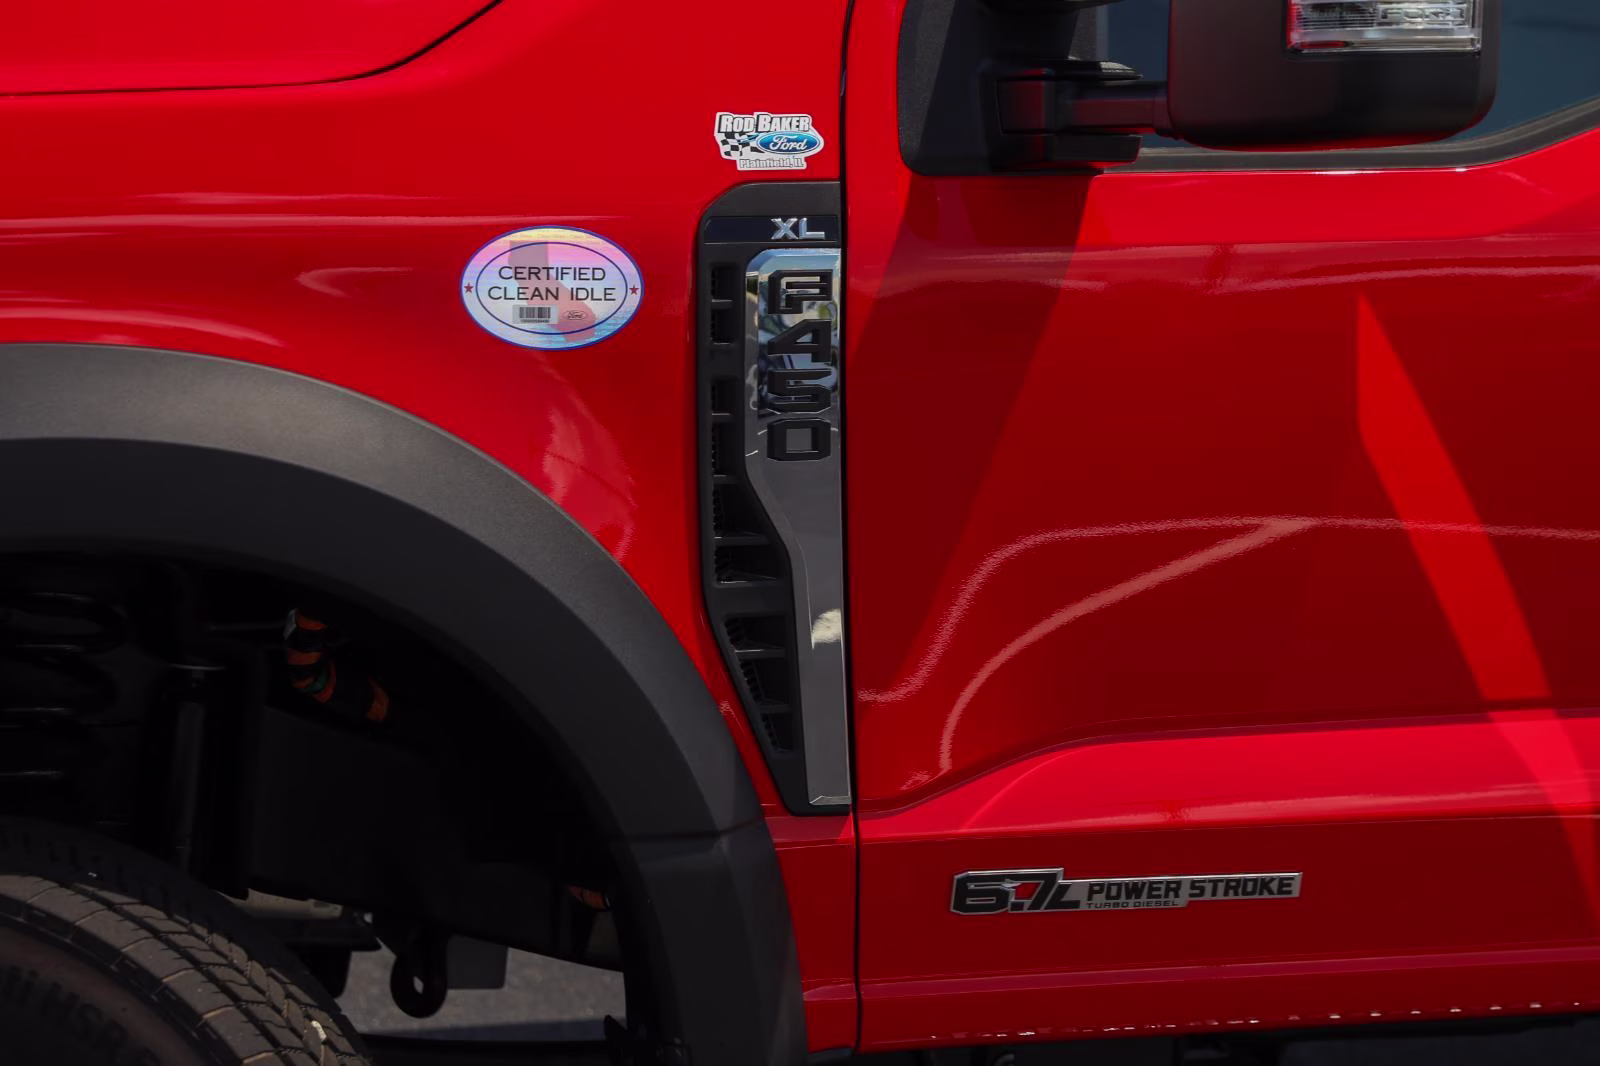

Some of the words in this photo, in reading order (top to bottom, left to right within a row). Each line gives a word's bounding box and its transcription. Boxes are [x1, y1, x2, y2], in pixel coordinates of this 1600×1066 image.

[756, 114, 810, 133] BAKER
[769, 135, 808, 150] Ford
[771, 217, 825, 240] XL
[498, 266, 606, 281] CERTIFIED
[487, 286, 559, 301] CLEAN
[570, 287, 616, 301] IDLE
[951, 868, 1081, 915] 6.7L
[1087, 880, 1182, 901] POWER
[1188, 876, 1295, 898] STROKE
[1086, 901, 1129, 909] TURBO
[1133, 900, 1179, 908] DIESEL
